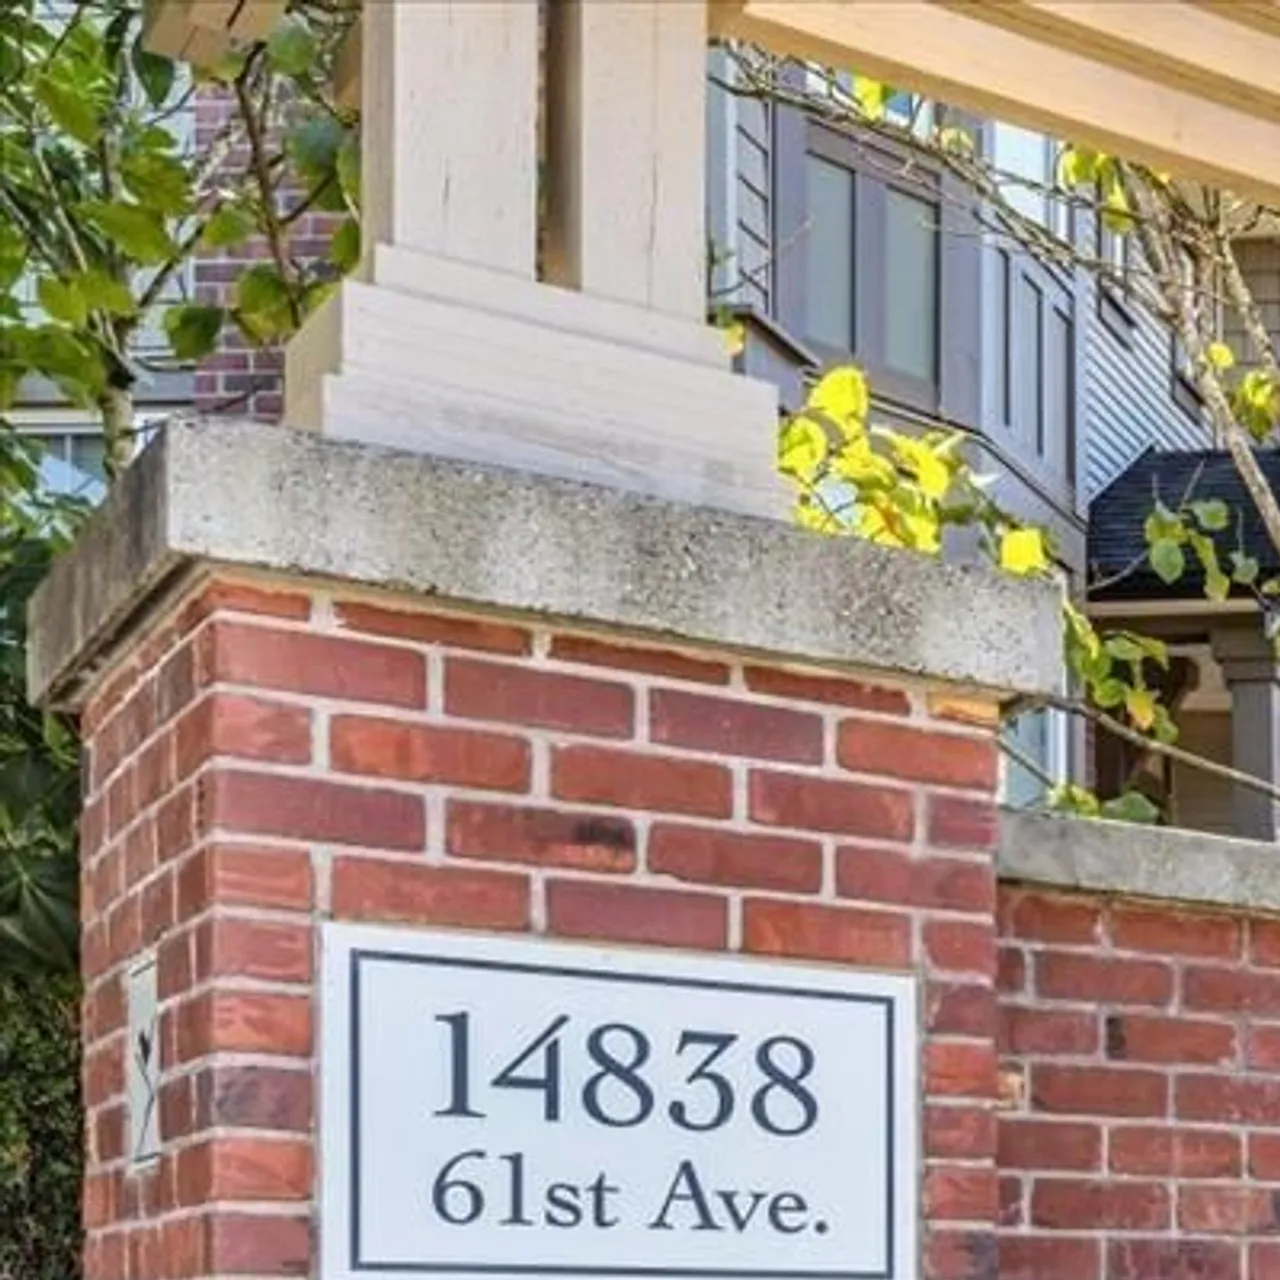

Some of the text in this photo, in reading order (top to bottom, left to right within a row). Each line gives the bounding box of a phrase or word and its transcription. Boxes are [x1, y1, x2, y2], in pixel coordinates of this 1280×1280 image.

[432, 1011, 819, 1137] 14838
[431, 1150, 829, 1235] 61st Ave.
